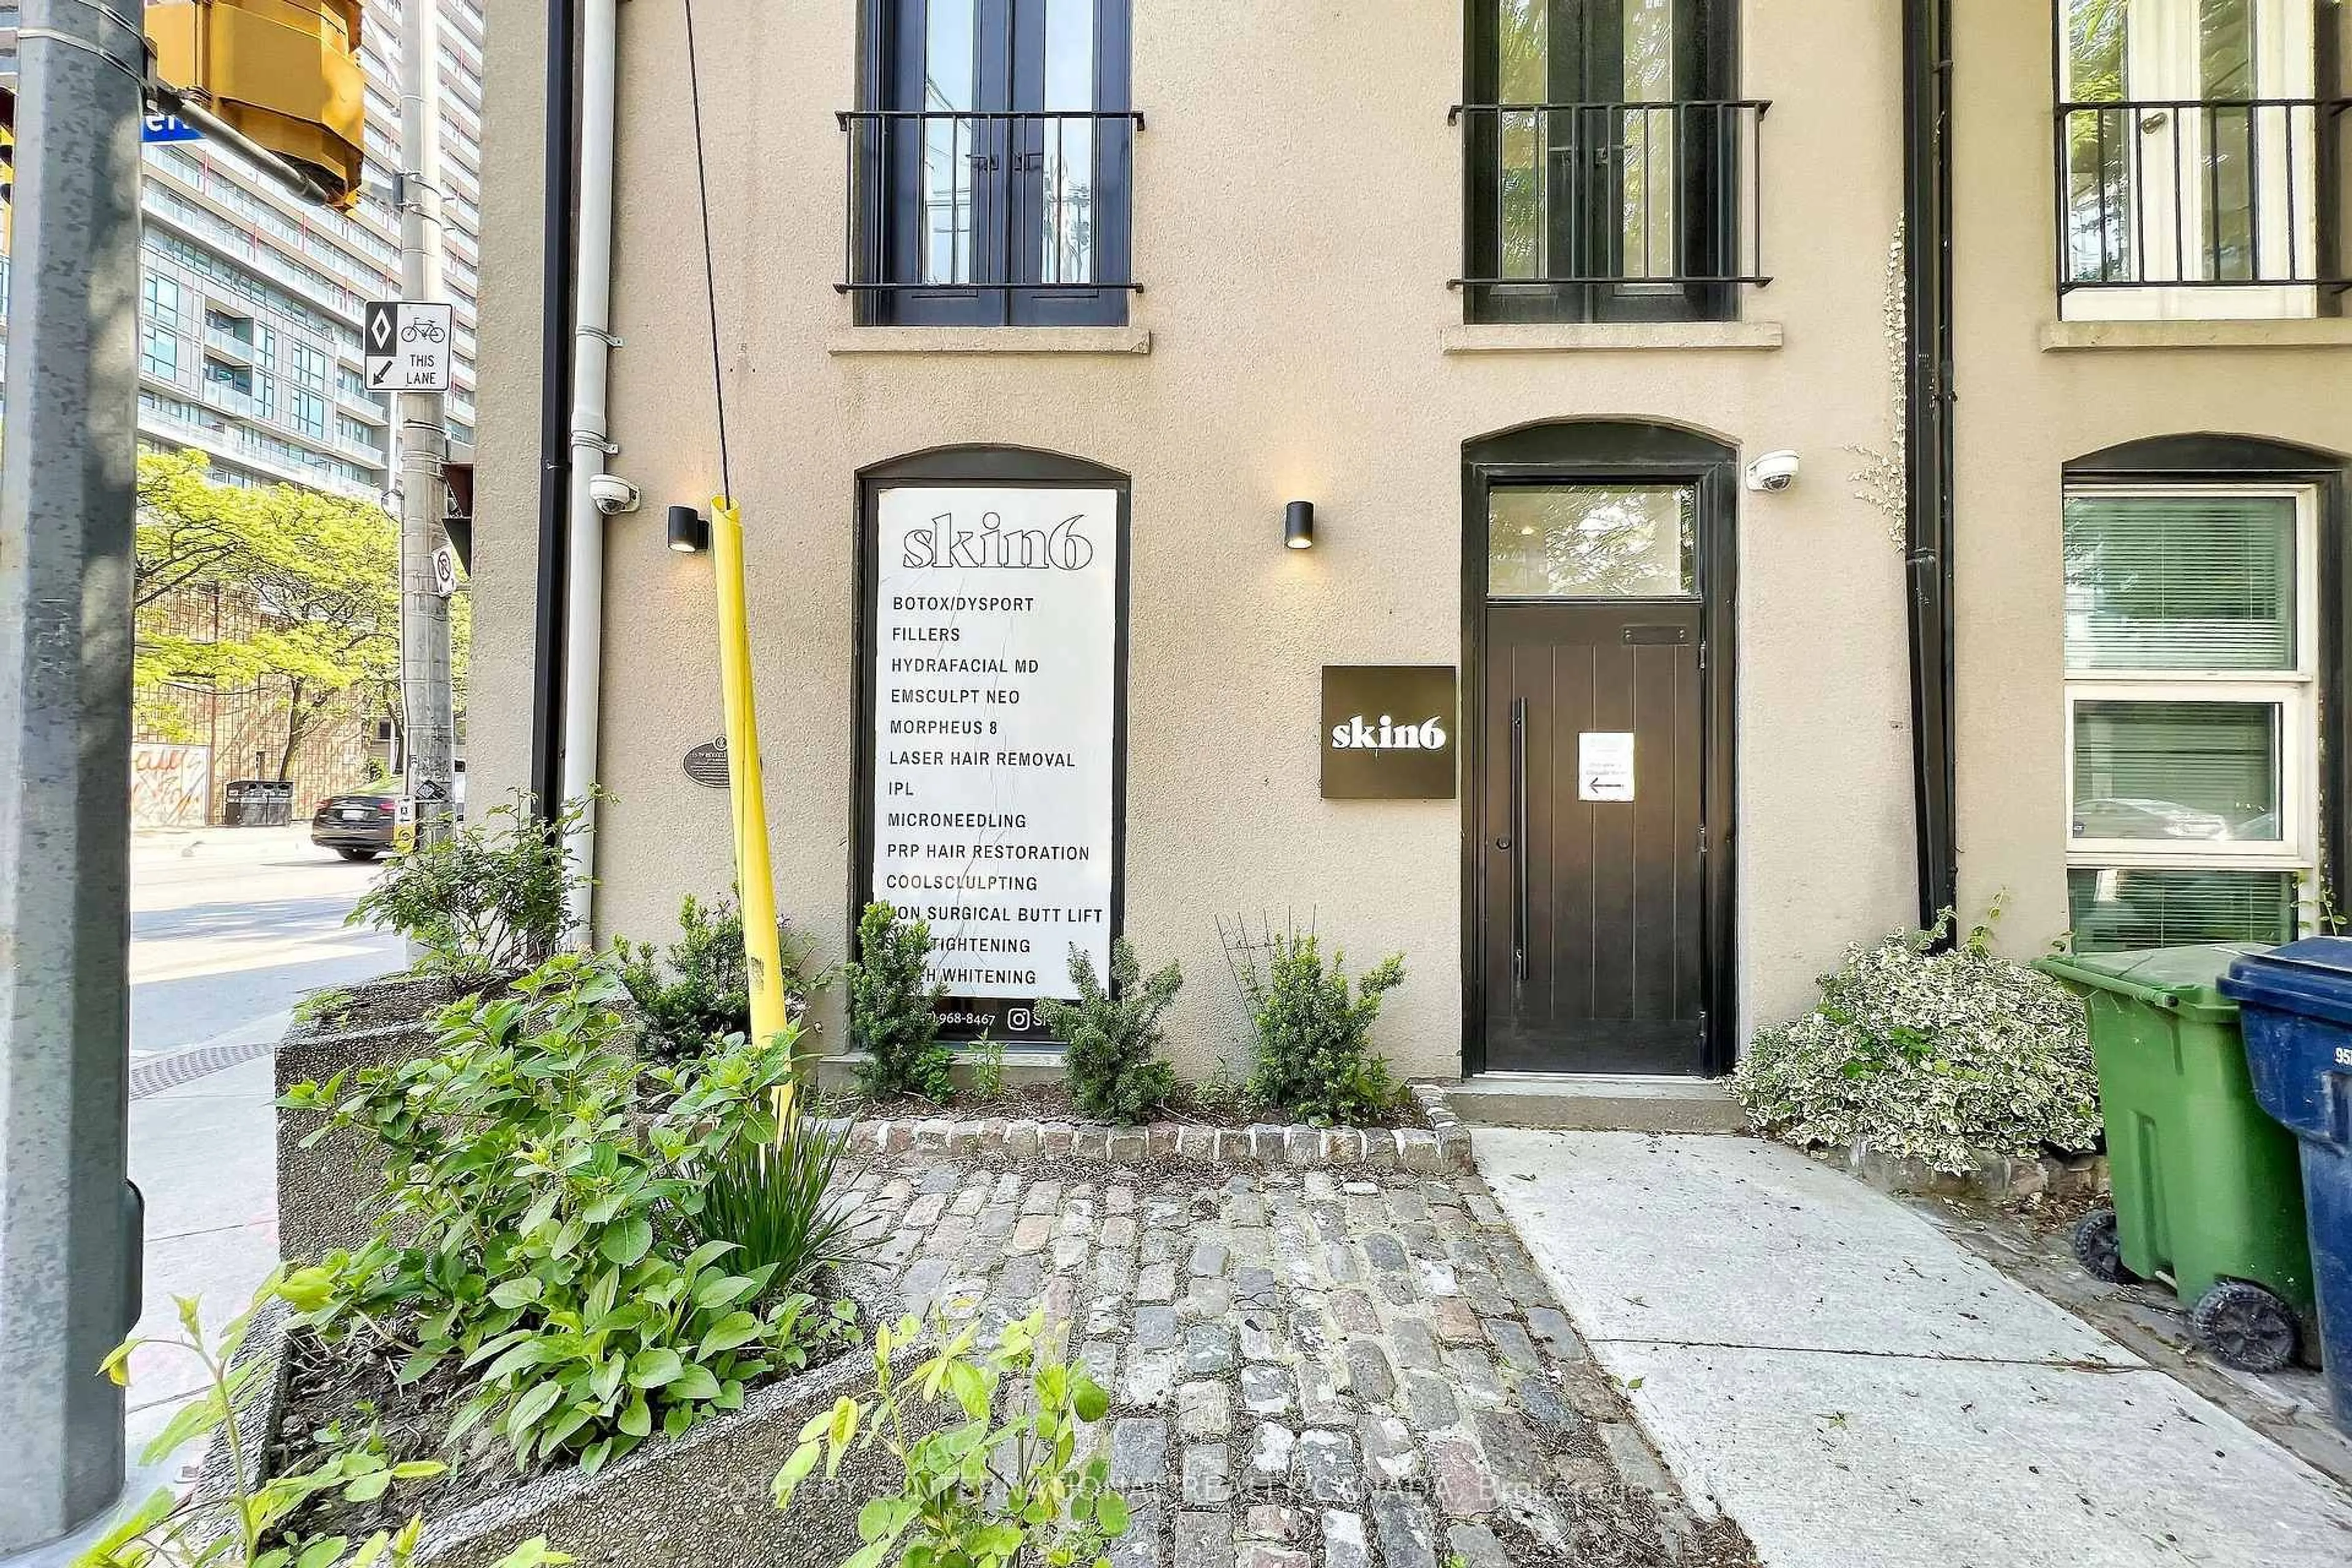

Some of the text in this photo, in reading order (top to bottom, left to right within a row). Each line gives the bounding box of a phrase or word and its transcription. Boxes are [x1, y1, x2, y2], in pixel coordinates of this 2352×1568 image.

[410, 354, 434, 367] THIS
[407, 372, 436, 384] LANE
[902, 511, 1093, 570] skin6
[893, 597, 1034, 611] BOTOX/DYSPORT
[892, 628, 960, 641] FILLERS
[892, 658, 1039, 674] HYDRAFACIAL MD
[891, 689, 1020, 704] EMSCULPT NEO
[890, 720, 997, 735] MORPHEUS 8
[1332, 715, 1446, 750] skin6
[889, 751, 1076, 767] LASER HAIR REMOVAL
[888, 782, 914, 796] IPL
[888, 813, 1027, 828] MICRONEEDLING
[887, 845, 1089, 860] PRP HAIR RESTORATION
[891, 906, 1102, 922] ON SURGICAL BUTT LIFT
[931, 938, 1030, 952] TIGHTENING
[943, 968, 1036, 984] WHITENING
[939, 1012, 995, 1026] 968-8467
